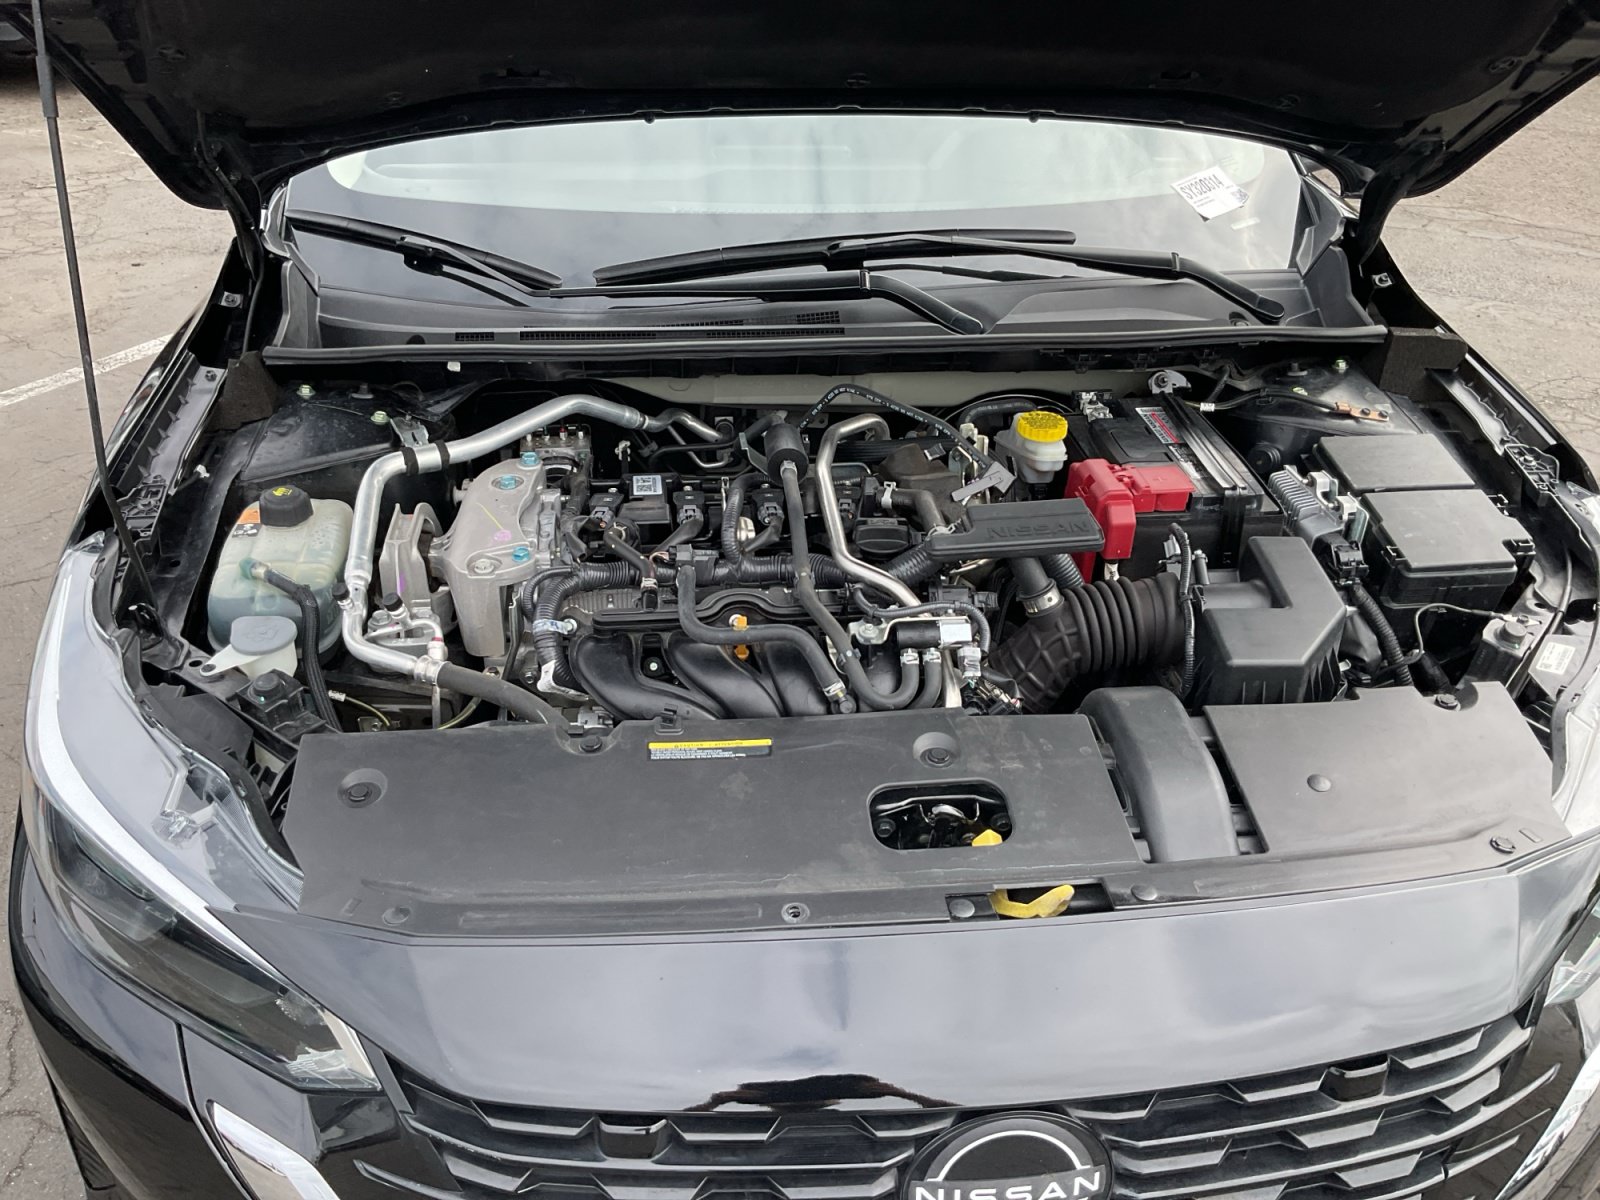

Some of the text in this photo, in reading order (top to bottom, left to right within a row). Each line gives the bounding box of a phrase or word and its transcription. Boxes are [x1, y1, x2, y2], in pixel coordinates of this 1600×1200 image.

[1180, 174, 1224, 200] SY320314
[986, 521, 1090, 538] NISSAN
[915, 1171, 1100, 1200] NISSAN
